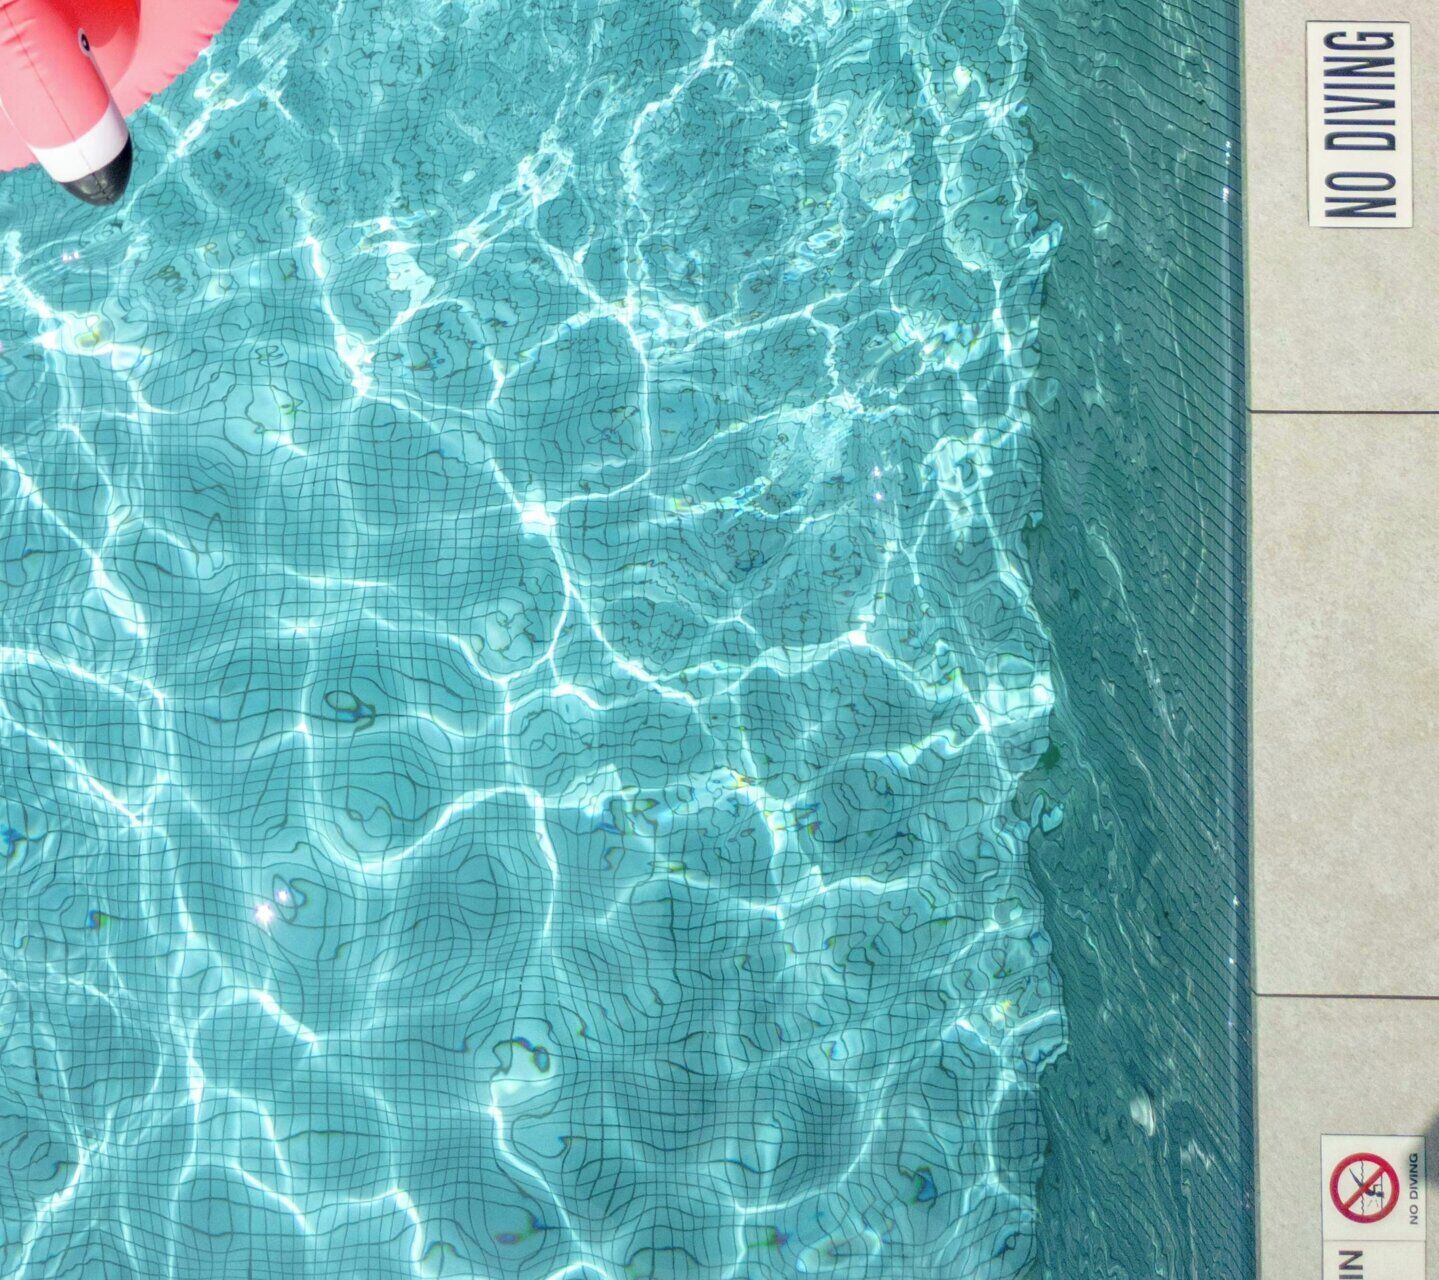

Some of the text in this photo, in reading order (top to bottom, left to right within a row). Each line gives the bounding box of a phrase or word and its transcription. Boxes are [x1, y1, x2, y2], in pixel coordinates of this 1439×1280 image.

[1323, 31, 1397, 218] NO DIVING
[1409, 1152, 1419, 1225] NO DIVING
[1338, 1250, 1364, 1280] IN
